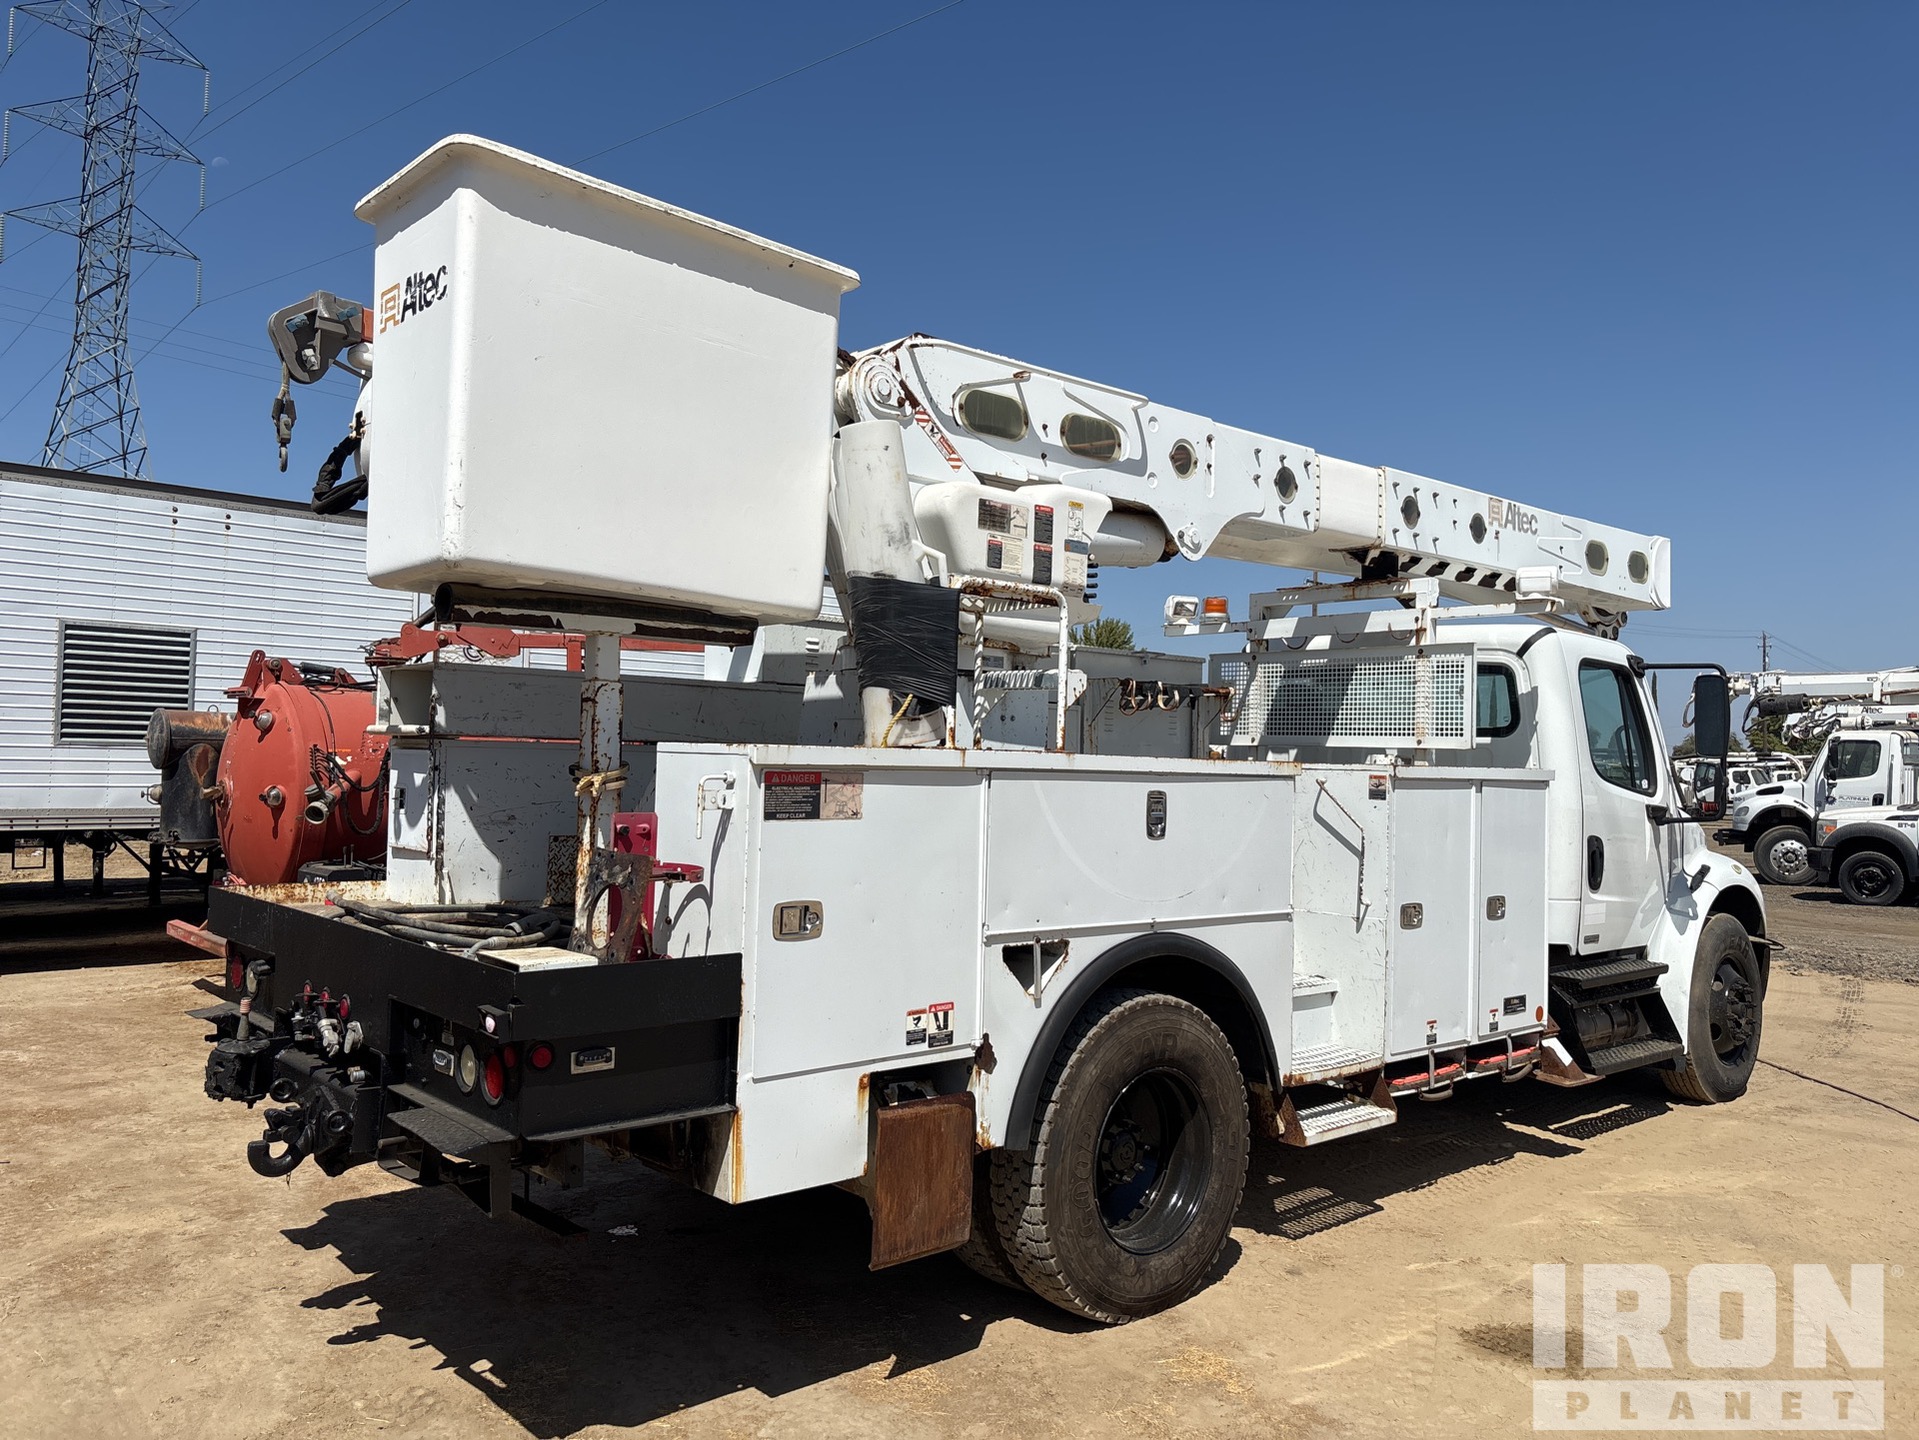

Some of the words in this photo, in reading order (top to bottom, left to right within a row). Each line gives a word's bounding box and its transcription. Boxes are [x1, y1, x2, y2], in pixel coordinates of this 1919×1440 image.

[401, 265, 448, 323] Altec
[1504, 502, 1538, 536] Altec
[1861, 706, 1883, 714] Altec
[781, 774, 816, 782] DANGER
